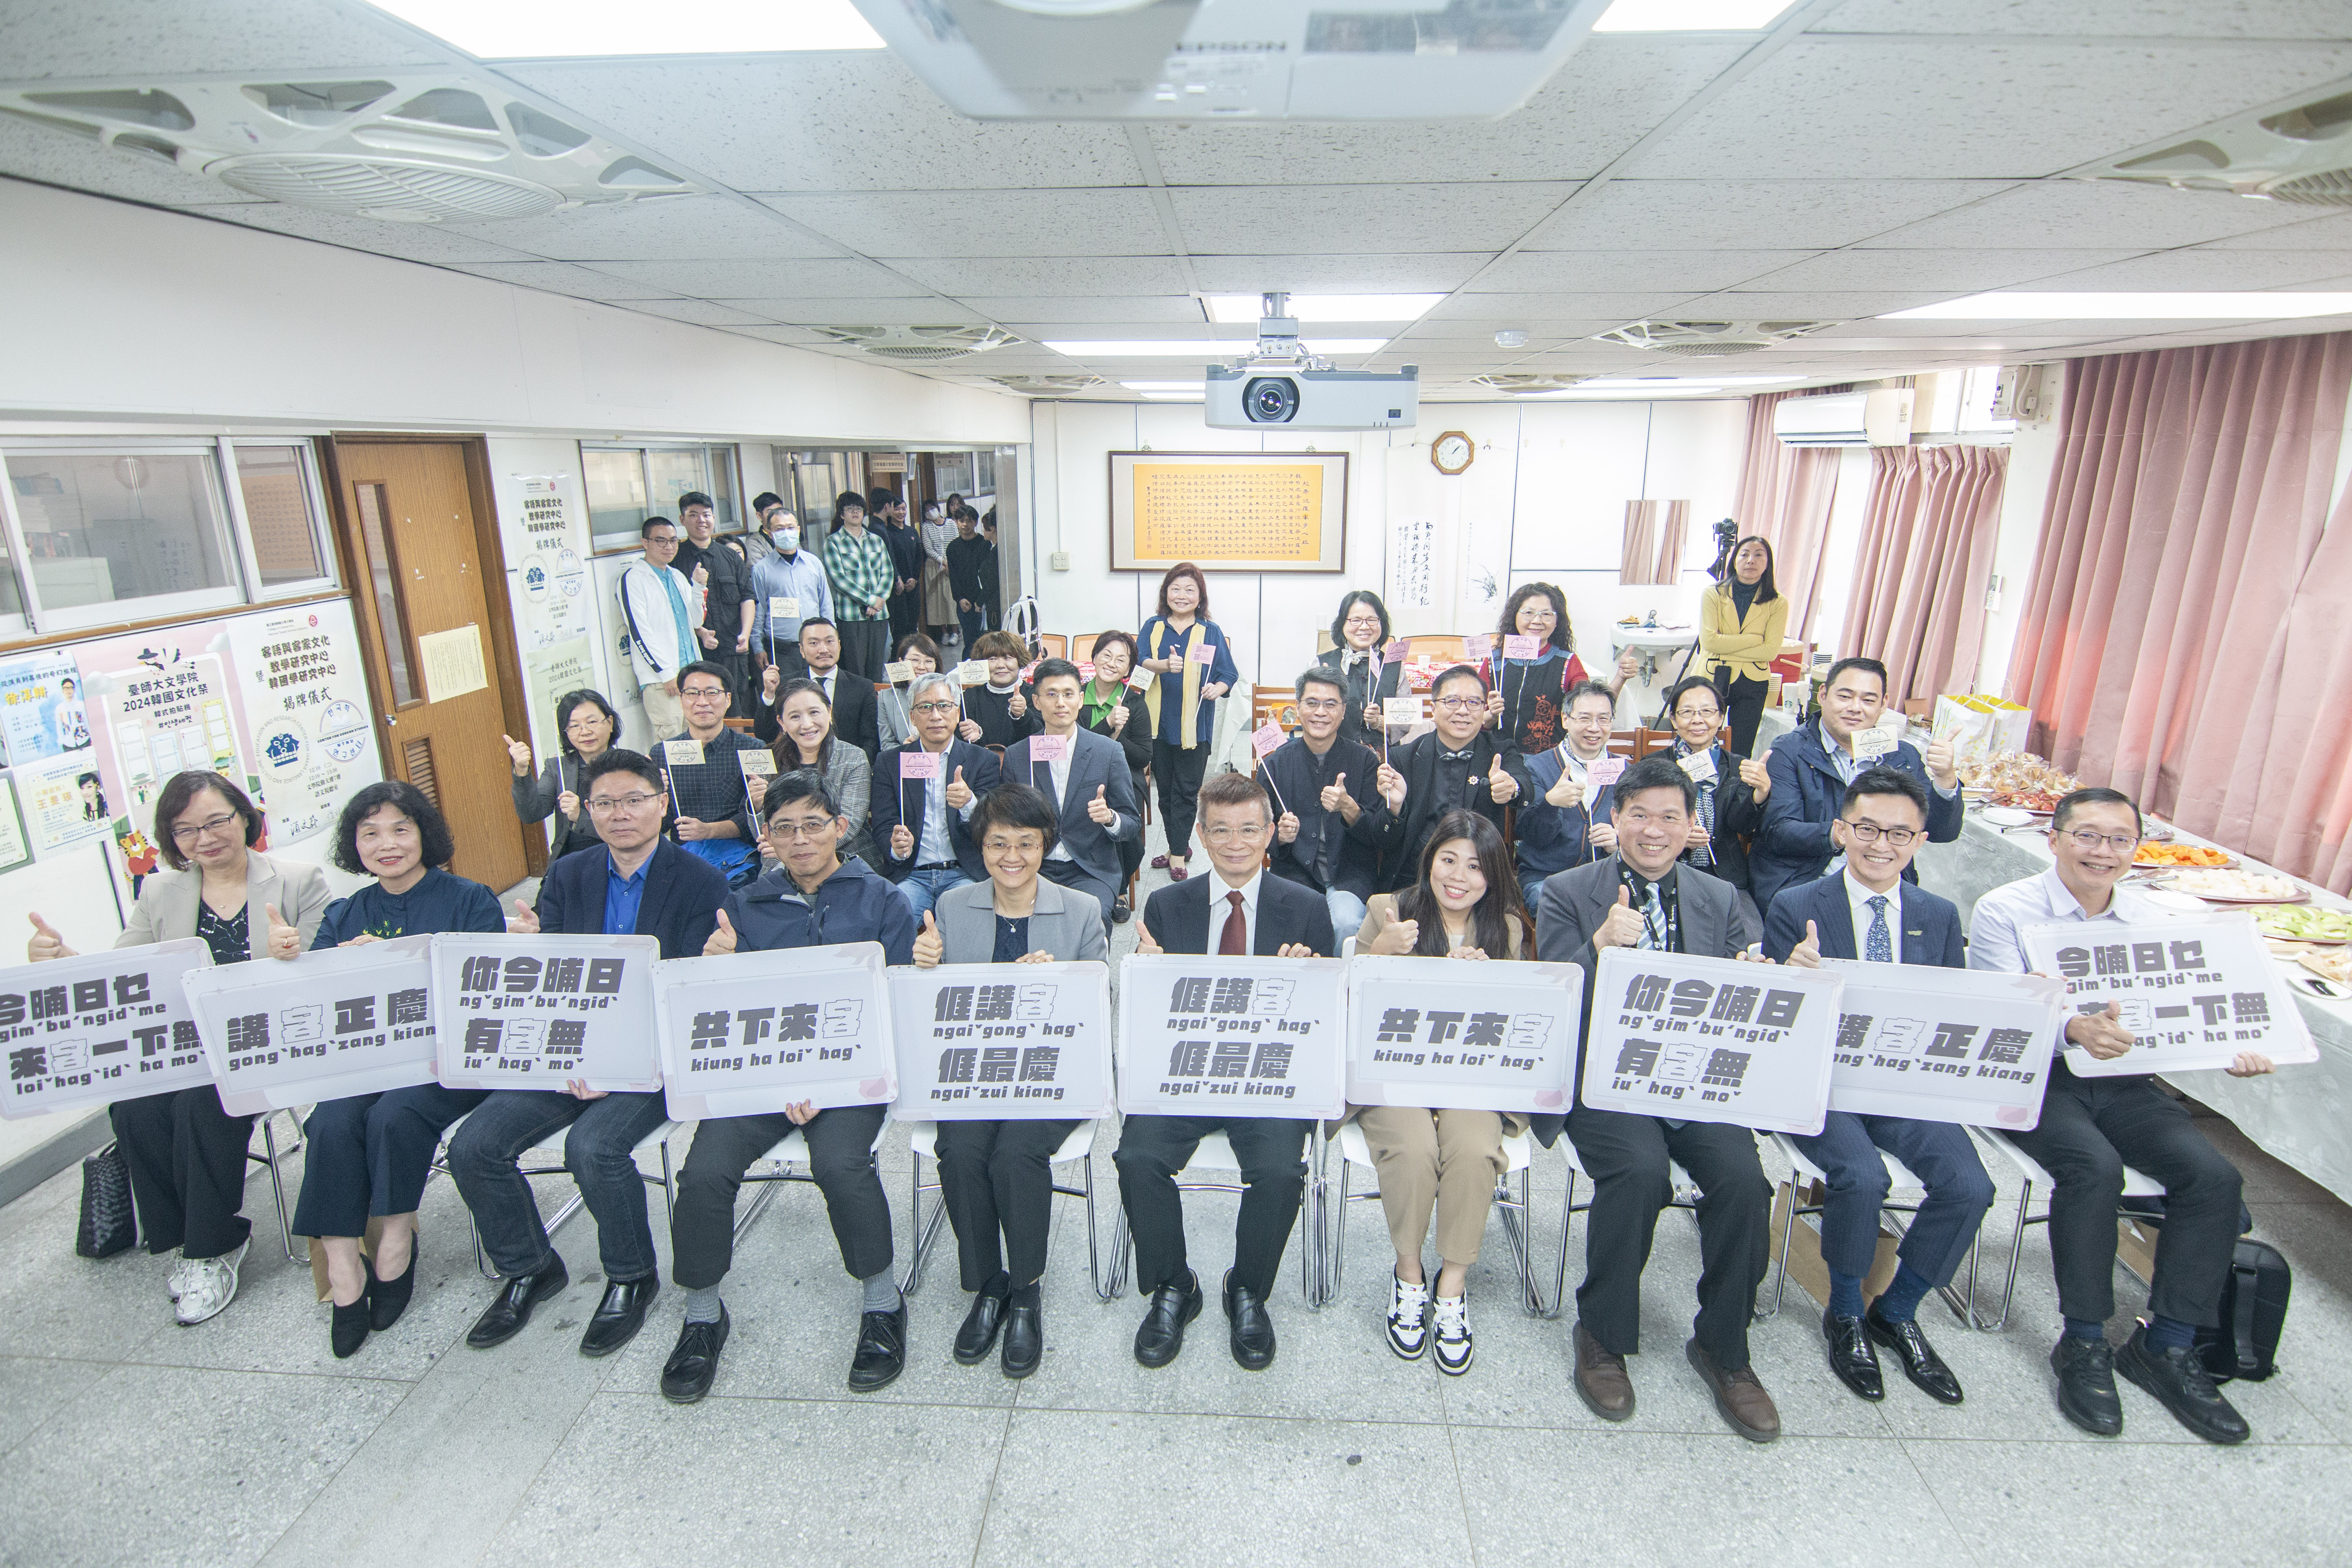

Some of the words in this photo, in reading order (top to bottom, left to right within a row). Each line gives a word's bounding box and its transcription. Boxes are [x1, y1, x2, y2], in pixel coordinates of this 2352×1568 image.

[261, 635, 330, 658] 客語與客家文化
[269, 650, 329, 673] 教學研究中心
[128, 671, 199, 697] 臺師大文學院
[255, 670, 264, 682] 暨
[268, 664, 336, 689] 韓國學研究中心
[123, 684, 208, 712] 2024韓國文化祭
[284, 687, 332, 711] 揭牌儀式
[154, 704, 191, 717] 韓式拍貼機
[328, 704, 350, 717] 한국학
[354, 725, 369, 733] STUDIES
[333, 740, 362, 759] 연구센터
[337, 739, 354, 747] NTNU
[2057, 940, 2205, 977] 今晡日乜
[461, 956, 625, 993] 你今晡日
[1623, 974, 1805, 1028] 你今晡日
[227, 988, 427, 1053] 講客正慶
[691, 999, 863, 1050] 共下來客
[1376, 1008, 1554, 1049] 共下來客
[394, 1026, 436, 1041] kian
[465, 1018, 587, 1054] 有客無
[2203, 1030, 2227, 1042] ha
[140, 1060, 163, 1072] ha
[692, 1057, 743, 1071] kiung
[750, 1054, 772, 1066] ha
[1374, 1050, 1425, 1065] kiung
[1432, 1052, 1454, 1064] ha
[1615, 1038, 1751, 1087] 有客無
[1976, 1065, 2036, 1084] kiang
[1014, 1086, 1064, 1100] kiang
[1244, 1082, 1295, 1098] kiang
